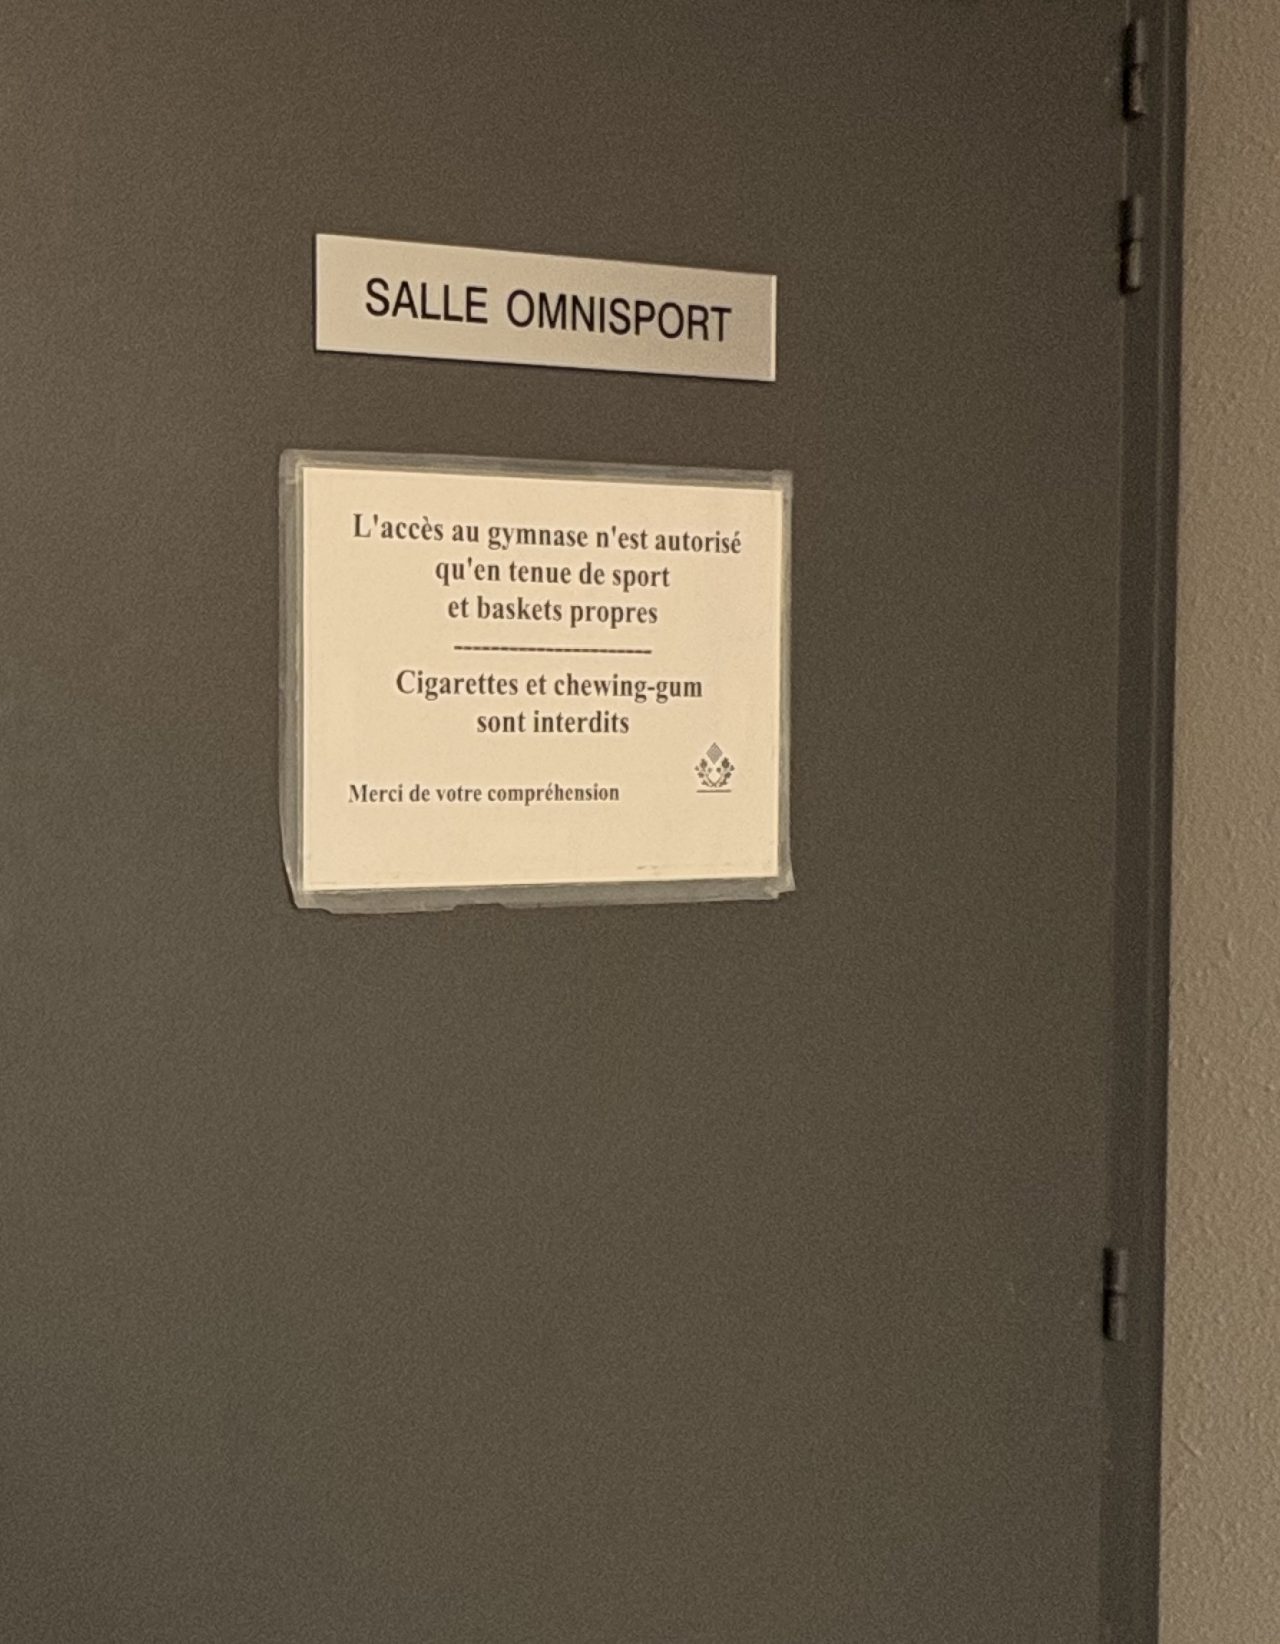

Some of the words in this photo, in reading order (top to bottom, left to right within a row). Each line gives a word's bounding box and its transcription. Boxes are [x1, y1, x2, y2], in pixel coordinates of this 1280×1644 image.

[365, 277, 488, 324] SALLE
[506, 289, 733, 343] OMNISPORT
[353, 513, 444, 541] L'accès
[451, 524, 479, 543] au
[487, 525, 589, 551] gymnase
[596, 525, 648, 551] n'est
[655, 529, 742, 554] autorisé
[435, 556, 501, 587] qu'en
[509, 561, 572, 585] tenue
[578, 561, 605, 586] de
[612, 567, 670, 593] sport
[447, 597, 469, 619] et
[476, 595, 563, 622] baskets
[570, 605, 658, 630] propres
[396, 669, 519, 702] Cigarettes
[526, 674, 548, 697] et
[554, 672, 703, 704] chewing-gum
[477, 711, 526, 733] sont
[533, 709, 630, 734] interdits
[348, 782, 404, 804] Merci
[409, 783, 432, 804] de
[436, 786, 483, 804] votre
[487, 782, 620, 807] compréhension
